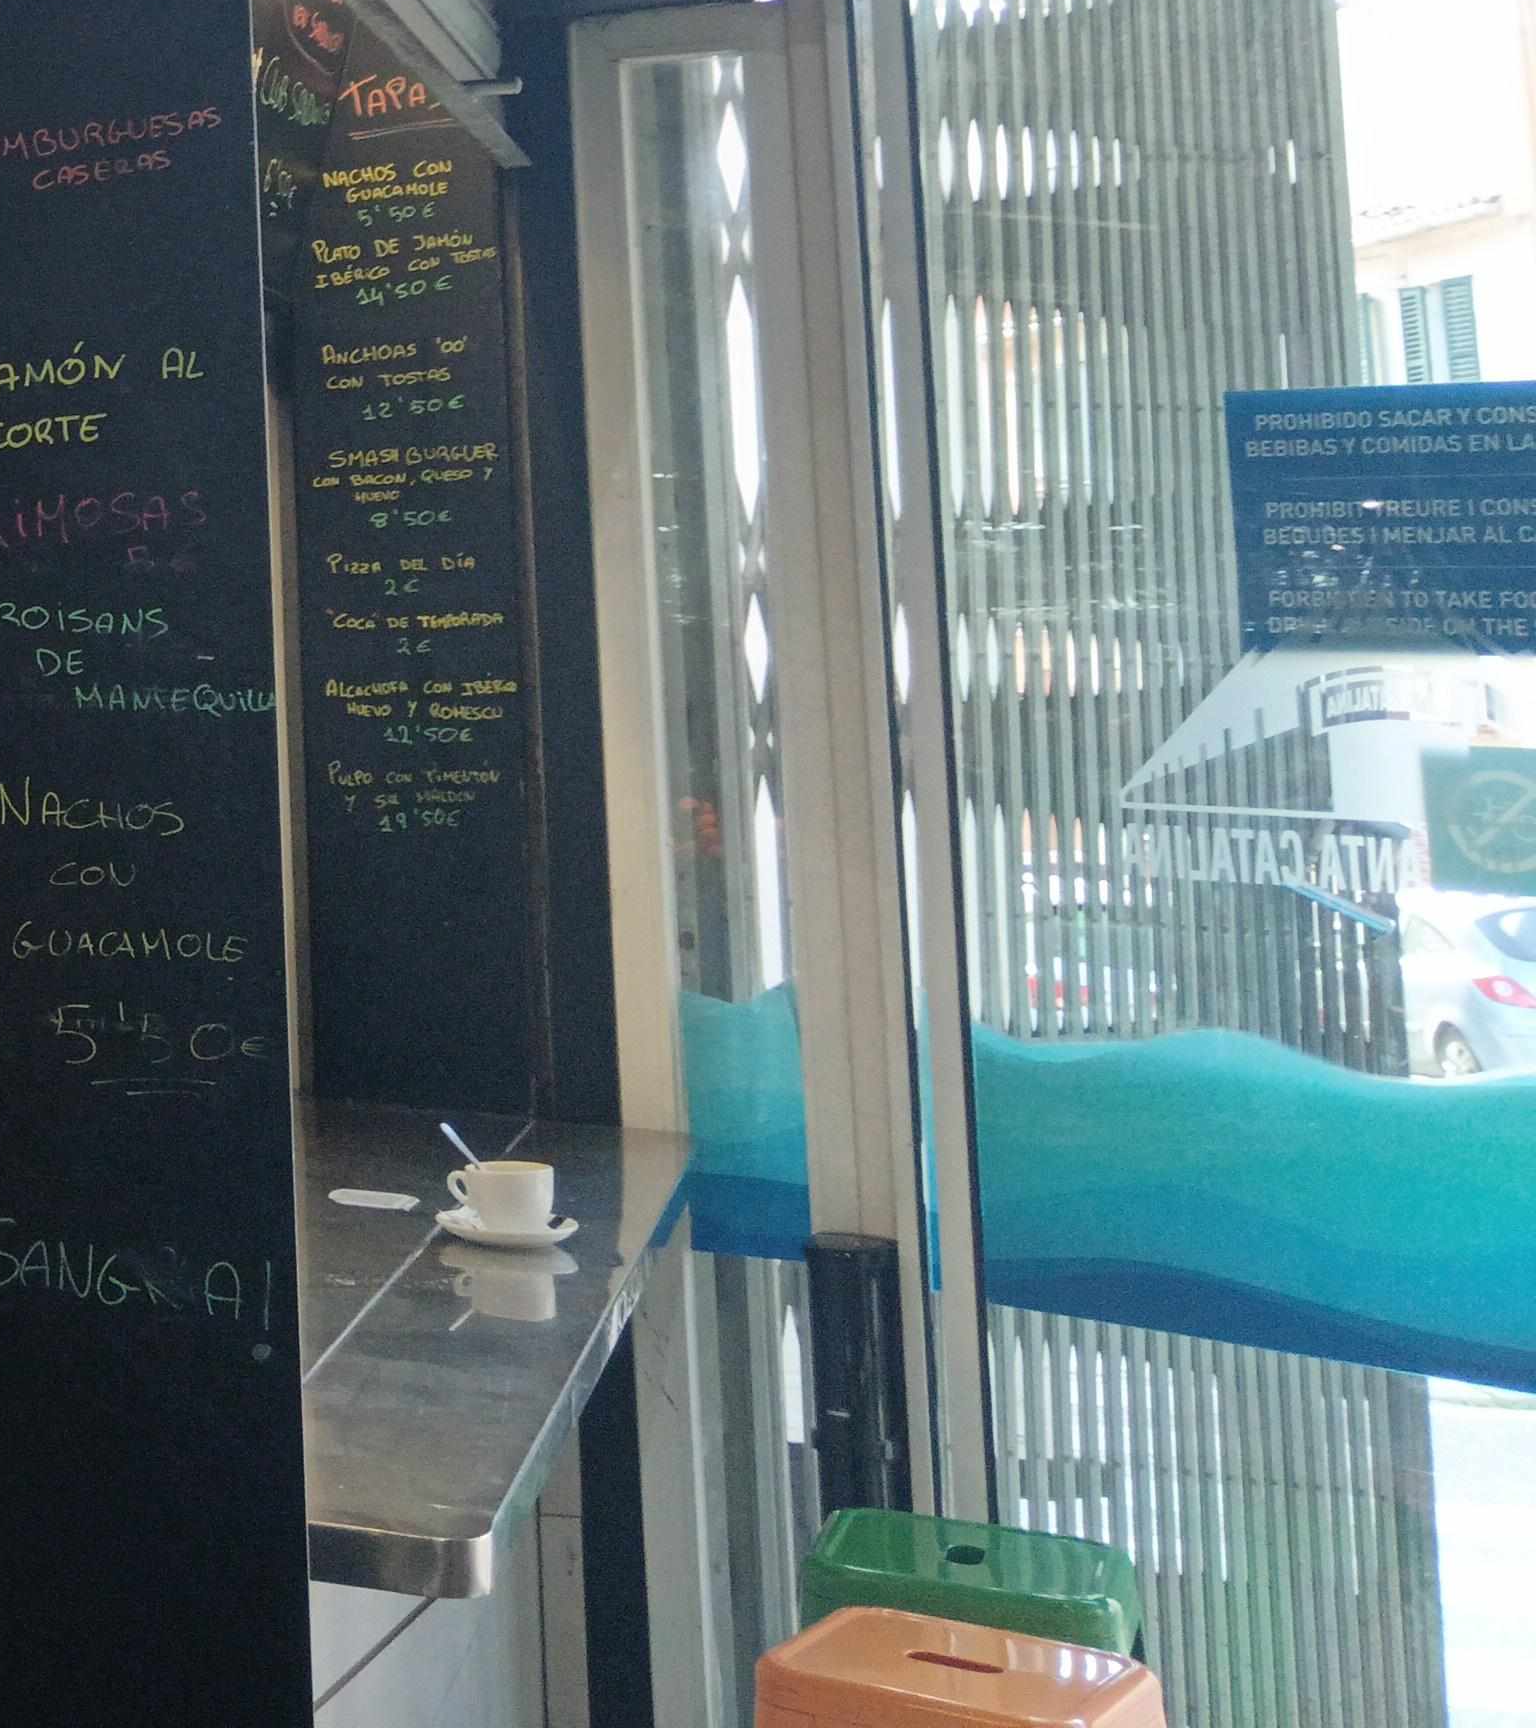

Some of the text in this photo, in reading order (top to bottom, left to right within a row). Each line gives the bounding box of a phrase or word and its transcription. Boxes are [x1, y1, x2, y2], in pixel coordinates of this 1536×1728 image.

[338, 74, 442, 118] TAPA
[32, 149, 172, 191] CASERAS
[322, 160, 454, 189] NACHOS CON
[345, 181, 450, 204] GUACAMOLE
[312, 229, 474, 265] PLATO DE JAMÓN
[407, 255, 441, 273] CON
[161, 346, 205, 380] AL
[321, 342, 417, 365] ANCHOAS
[325, 367, 453, 391] CON TOSTAS
[1255, 410, 1374, 433] PROHIBIDO
[1377, 407, 1453, 429] SACAR
[1453, 407, 1471, 426] Y
[405, 441, 500, 466] BURGUER
[1341, 437, 1356, 455] Y
[1360, 433, 1463, 455] COMIDAS
[1468, 432, 1501, 453] EN
[311, 475, 341, 489] CON
[420, 468, 474, 485] QUESO
[1265, 499, 1363, 520] PROHIBIT
[1382, 525, 1477, 545] MENJAR
[1482, 524, 1514, 545] AL
[325, 551, 477, 575] PIZZA DEL DÍA
[1435, 590, 1493, 609] TAKE
[386, 616, 410, 630] DE
[36, 648, 86, 678] DE
[325, 678, 454, 699] ALCACHOFA CON
[346, 701, 393, 718] HUEVO
[406, 700, 418, 720] Y
[326, 760, 374, 787] PULPO
[48, 860, 137, 888] CON
[11, 919, 249, 964] GUACAMOLE
